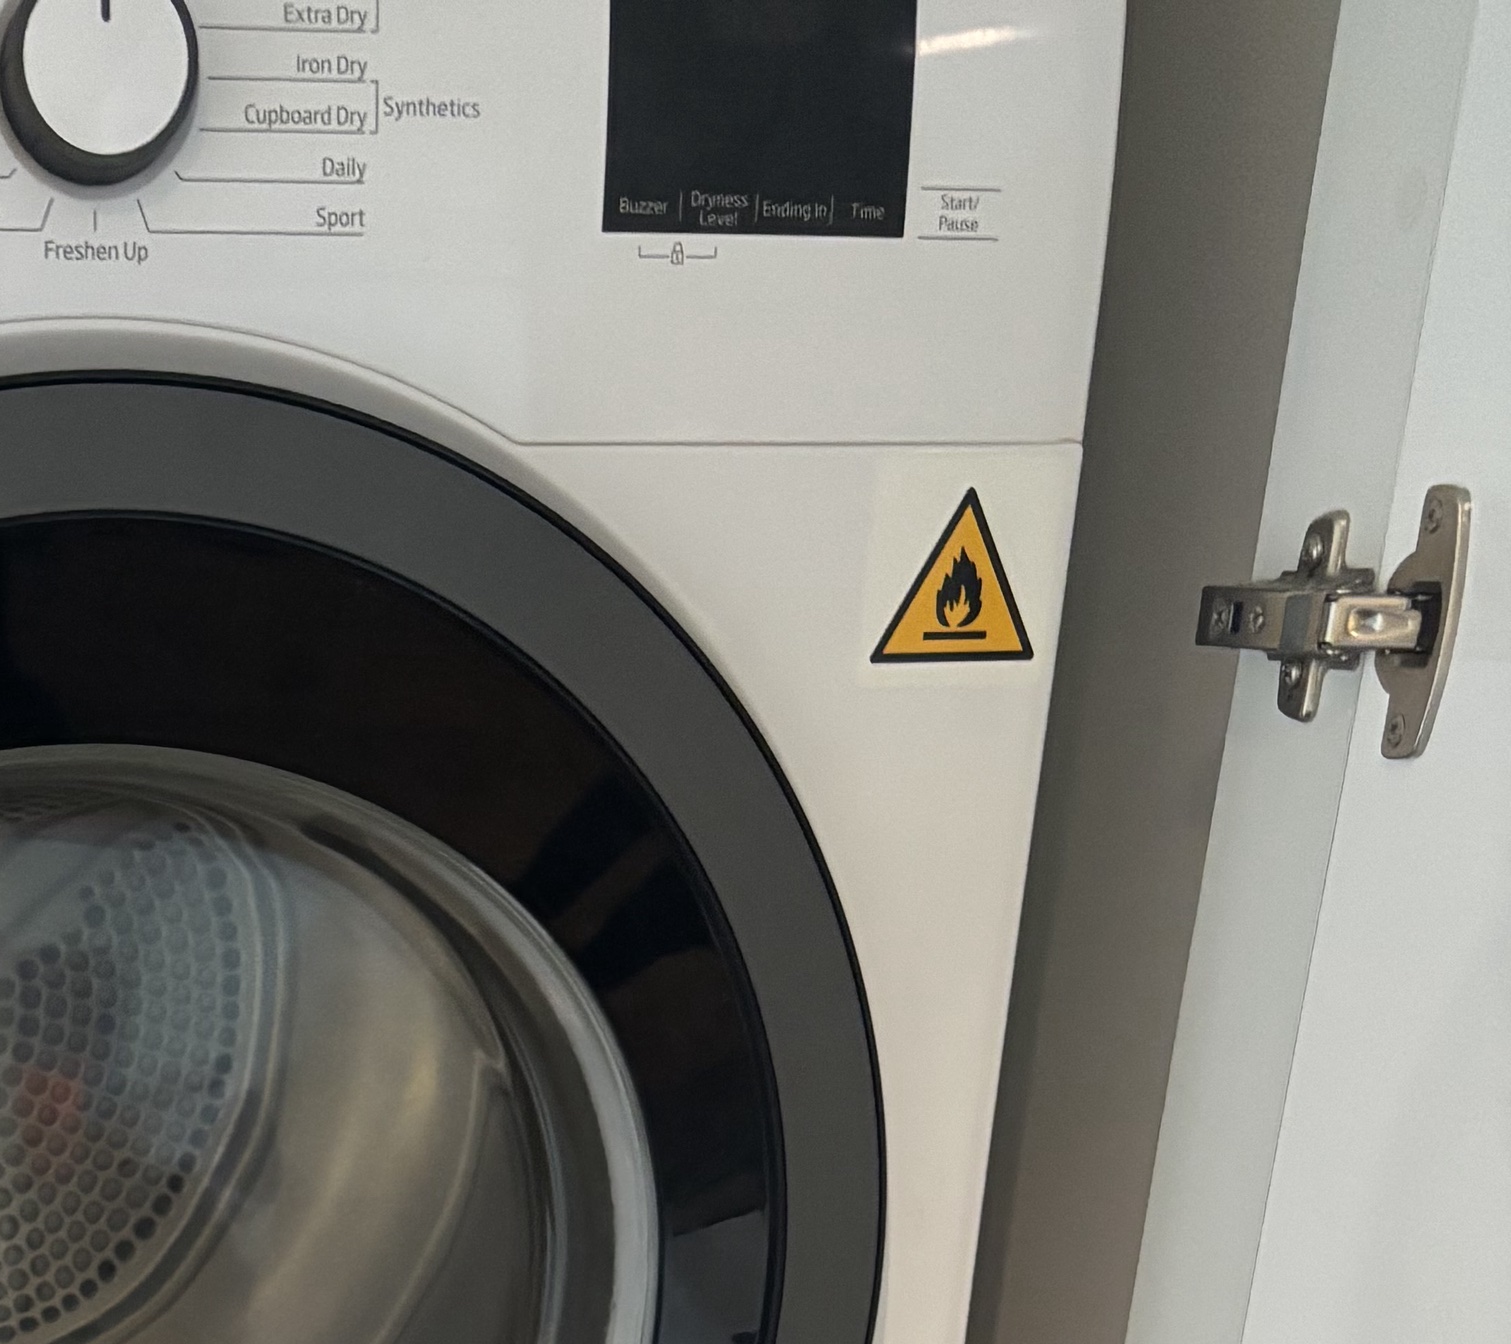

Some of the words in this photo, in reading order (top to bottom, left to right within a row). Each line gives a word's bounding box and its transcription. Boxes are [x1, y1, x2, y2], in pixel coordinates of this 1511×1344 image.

[283, 3, 332, 23] Extra
[336, 5, 367, 31] Dry
[296, 54, 331, 74] Iron
[336, 55, 367, 81] Dry
[244, 103, 331, 129] Cupboard
[336, 105, 367, 131] Dry
[383, 97, 480, 121] Synthetics
[322, 157, 366, 182] Daily
[316, 206, 365, 231] Sport
[619, 197, 668, 216] Buzzer
[699, 210, 738, 226] Level
[762, 200, 810, 221] Ending
[851, 202, 885, 220] Time
[938, 215, 979, 232] Pause
[44, 240, 119, 261] Freshen
[123, 241, 149, 265] Up
